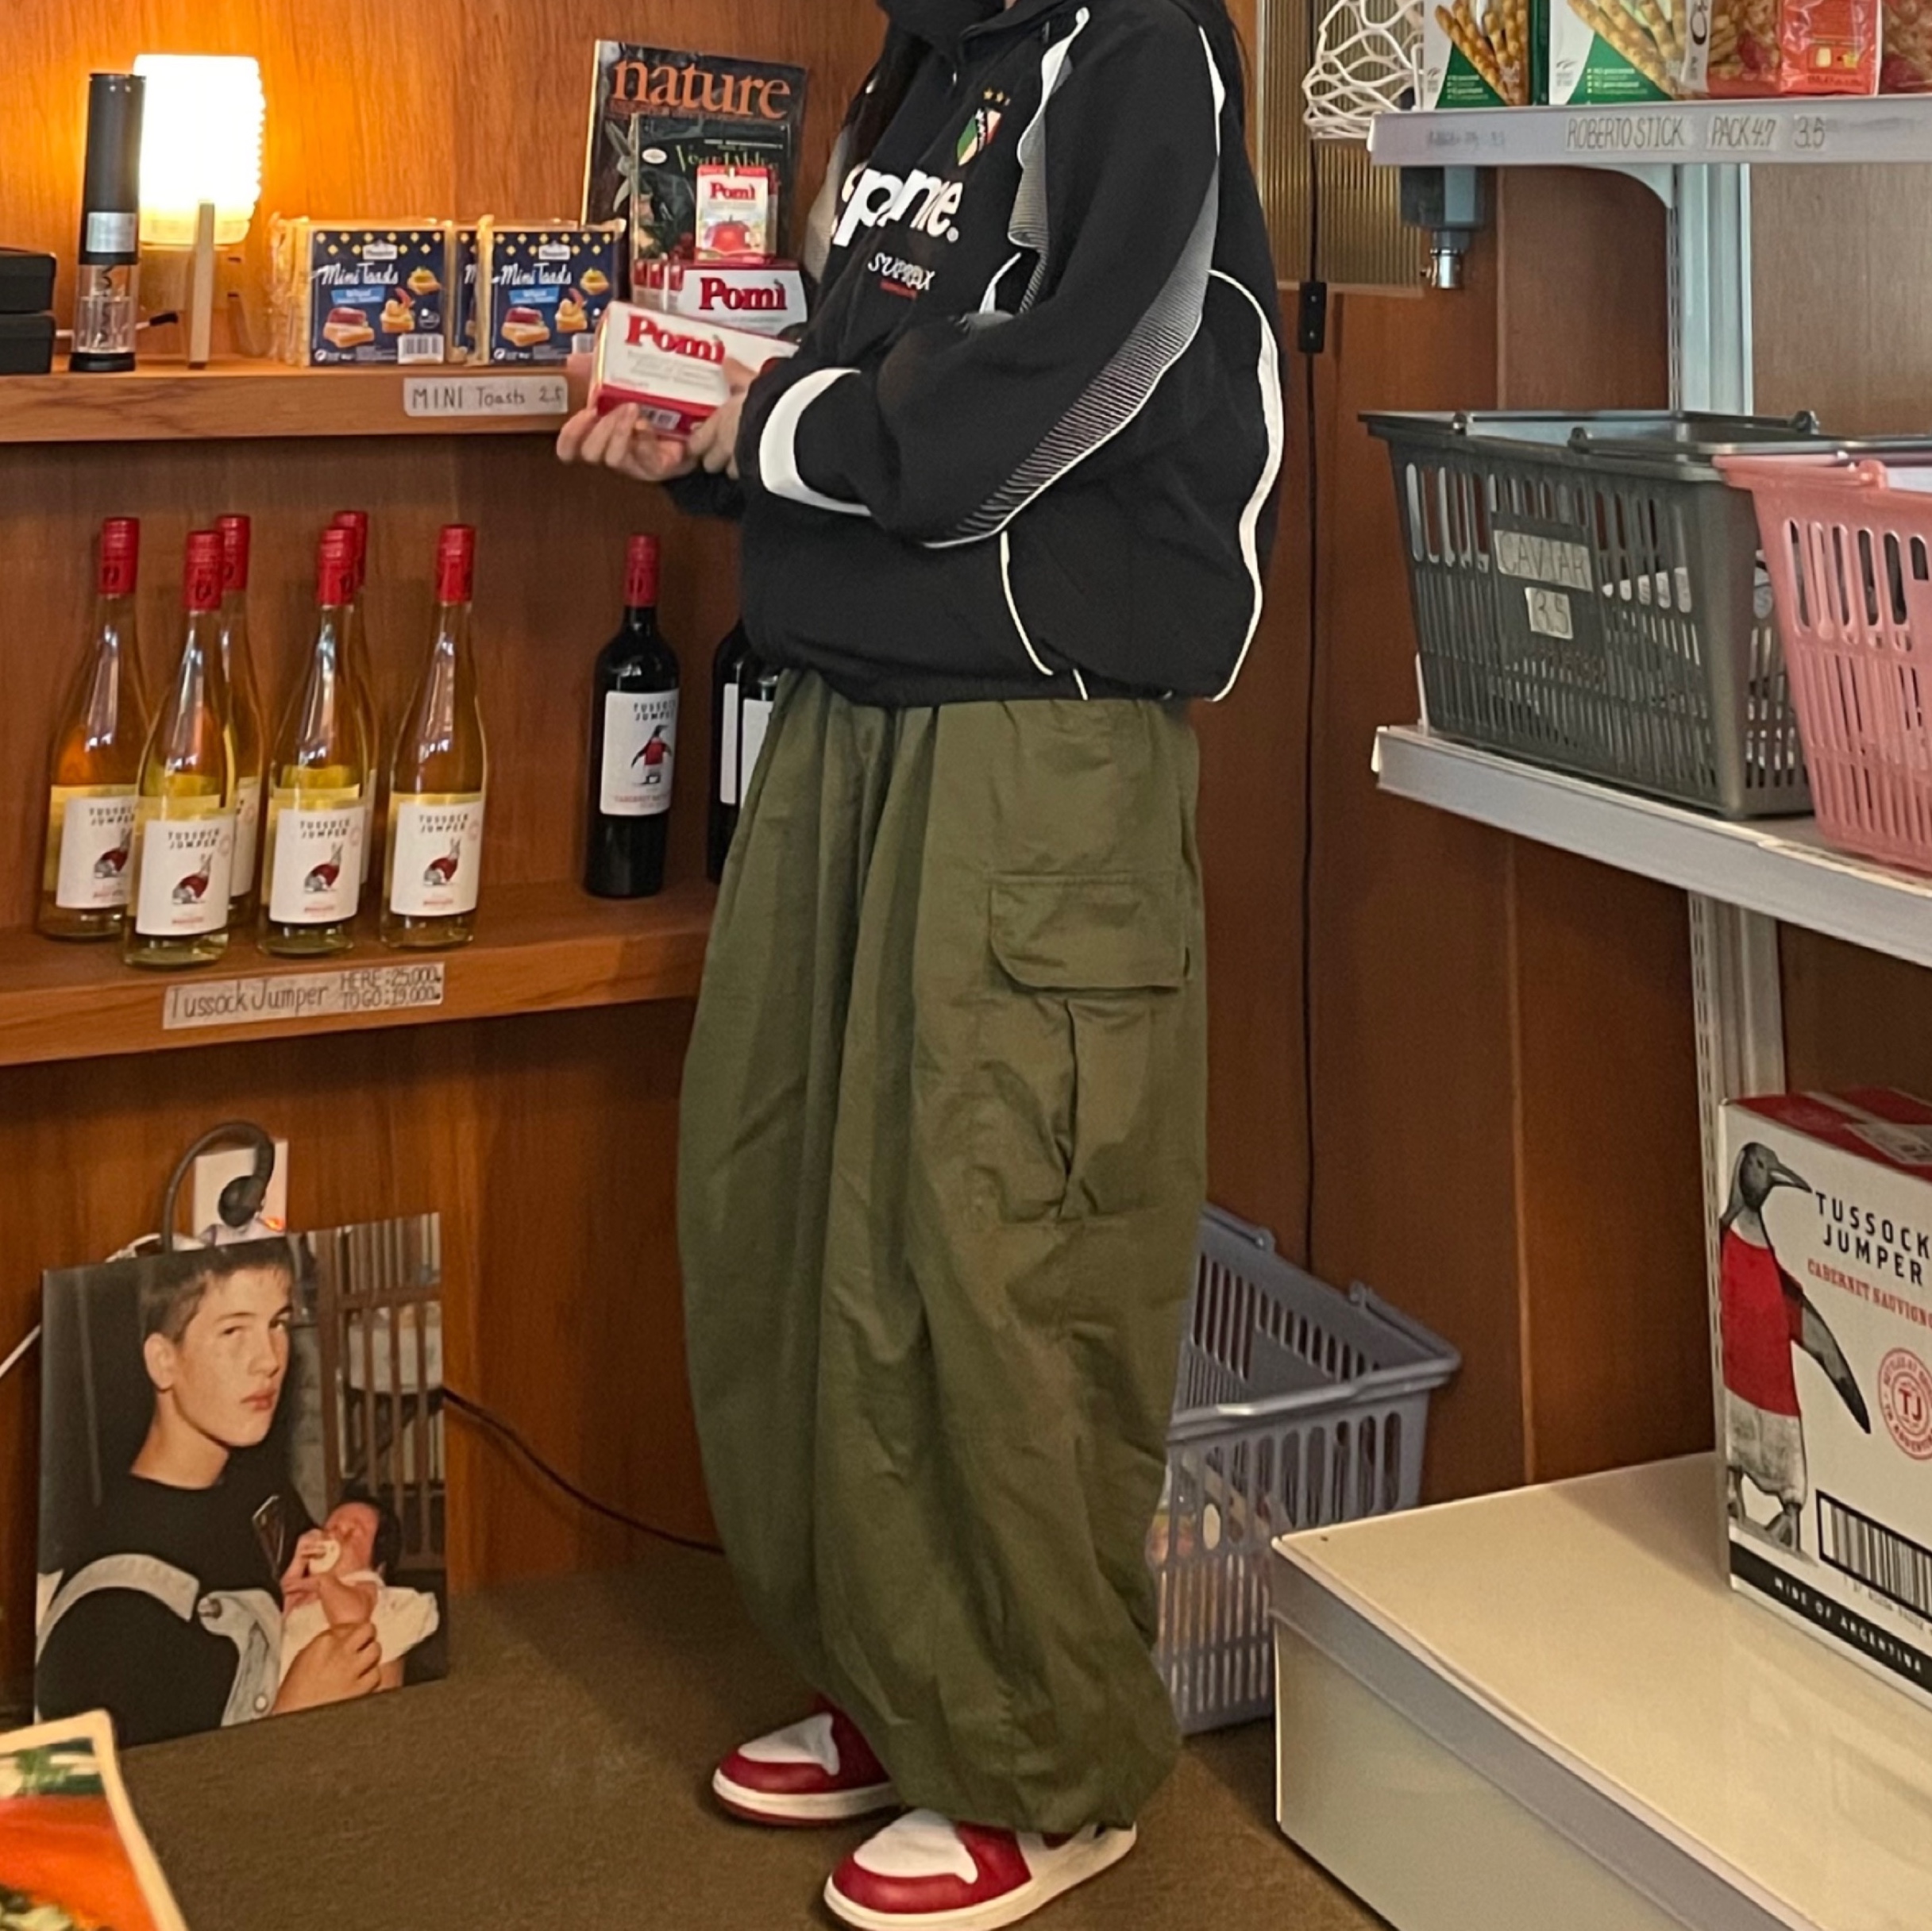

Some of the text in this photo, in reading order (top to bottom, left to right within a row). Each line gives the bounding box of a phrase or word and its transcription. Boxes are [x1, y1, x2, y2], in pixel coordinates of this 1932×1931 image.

[612, 59, 791, 119] nature
[1567, 118, 1633, 149] ROBERTO
[1634, 116, 1684, 148] STICK
[1710, 117, 1747, 148] PACK
[308, 263, 360, 285] Mini
[491, 262, 535, 286] Mini
[412, 386, 463, 410] MINI
[476, 386, 526, 409] Toasts
[1498, 532, 1589, 588] CAVIAR
[168, 979, 330, 1019] Tussock Jumper
[1815, 1191, 1930, 1260] TUSSOCK
[1823, 1224, 1922, 1288] JUMPER
[1807, 1257, 1870, 1301] CABERNET
[1898, 1387, 1922, 1422] TJ
[1774, 1576, 1807, 1606] WINE
[1815, 1599, 1832, 1620] OF
[1839, 1614, 1922, 1674] ARGENTINA
